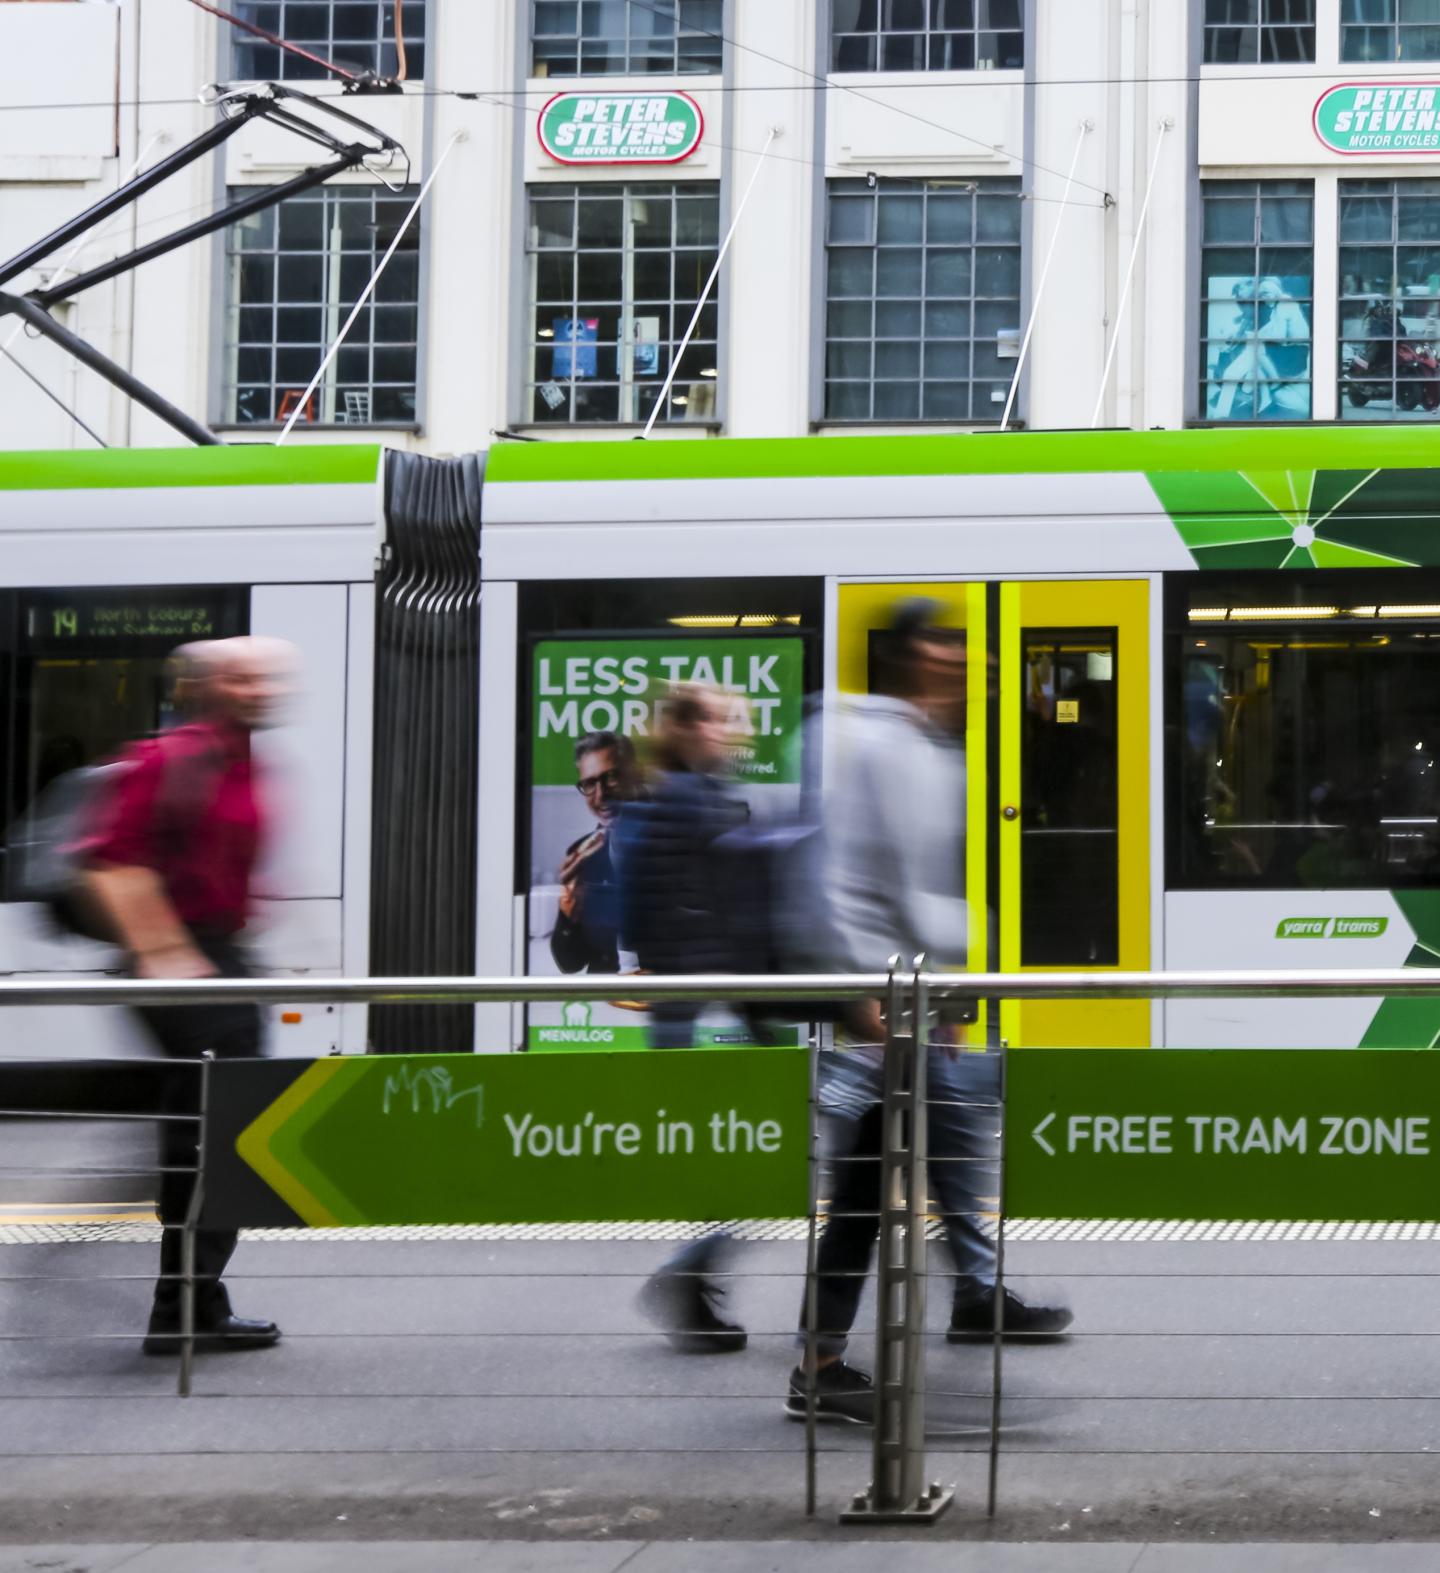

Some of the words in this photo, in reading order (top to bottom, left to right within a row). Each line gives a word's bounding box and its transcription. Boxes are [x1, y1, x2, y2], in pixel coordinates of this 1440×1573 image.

[572, 97, 669, 123] PETER
[1352, 88, 1437, 111] PETER
[554, 121, 687, 146] STEVENS
[1350, 134, 1391, 147] MOTOR
[1394, 134, 1439, 146] CYCLES
[572, 145, 617, 156] MOTOR
[619, 145, 667, 155] CYCLES
[539, 656, 649, 696] LESS
[659, 655, 781, 694] TALK
[1283, 921, 1323, 937] yarra
[1336, 920, 1379, 933] trams
[538, 1029, 615, 1043] MENULOG
[656, 1108, 694, 1155] in
[708, 1108, 782, 1154] the
[1067, 1115, 1174, 1154] FREE
[1185, 1115, 1308, 1155] TRAM
[1318, 1116, 1430, 1156] ZONE
